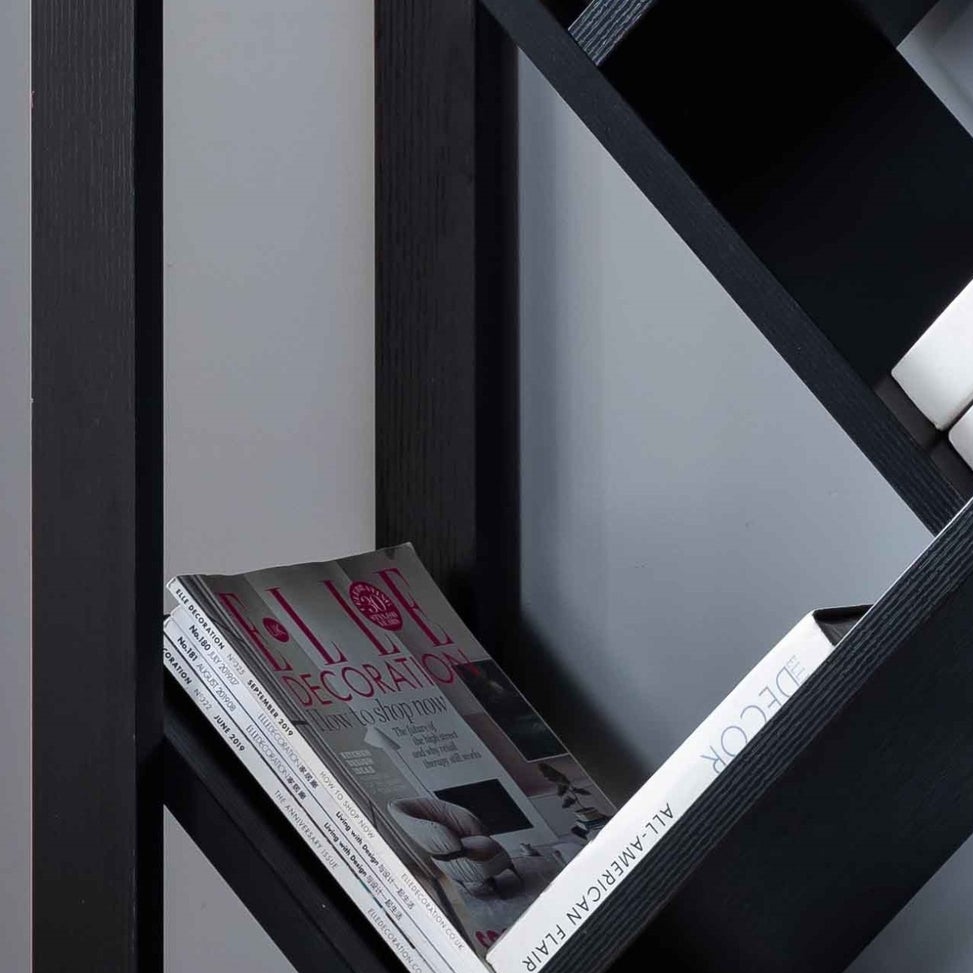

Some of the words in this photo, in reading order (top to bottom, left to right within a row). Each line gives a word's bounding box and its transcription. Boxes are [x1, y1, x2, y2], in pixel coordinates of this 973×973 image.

[219, 567, 454, 673] ELLE
[360, 594, 388, 613] 30
[176, 588, 190, 606] ELLE
[188, 604, 226, 650] DECORATION
[247, 679, 279, 719] SEPTEMBER
[278, 718, 295, 737] 2019
[320, 770, 336, 790] HOW
[333, 787, 344, 802] TO
[342, 799, 361, 821] SHOP
[358, 819, 376, 840] NOW
[282, 648, 480, 708] DECORATION
[308, 708, 354, 734] How
[347, 706, 376, 728] to
[373, 698, 414, 724] shop
[413, 695, 448, 717] now
[700, 666, 803, 775] DECOR
[177, 635, 199, 662] No.181
[196, 662, 220, 691] AUGUST
[323, 821, 340, 843] Living
[338, 840, 352, 857] with
[349, 854, 368, 878] Design
[189, 624, 212, 652] No.180
[335, 810, 352, 832] Living
[350, 829, 364, 846] with
[361, 843, 380, 867] Design
[213, 714, 231, 735] JUNE
[229, 733, 246, 752] 2019
[274, 789, 287, 805] THE
[284, 803, 324, 850] ANNIVERSARY
[321, 848, 340, 870] ISSUE
[566, 802, 675, 926] ALL-AMERICAN
[521, 923, 567, 973] FLAIR
